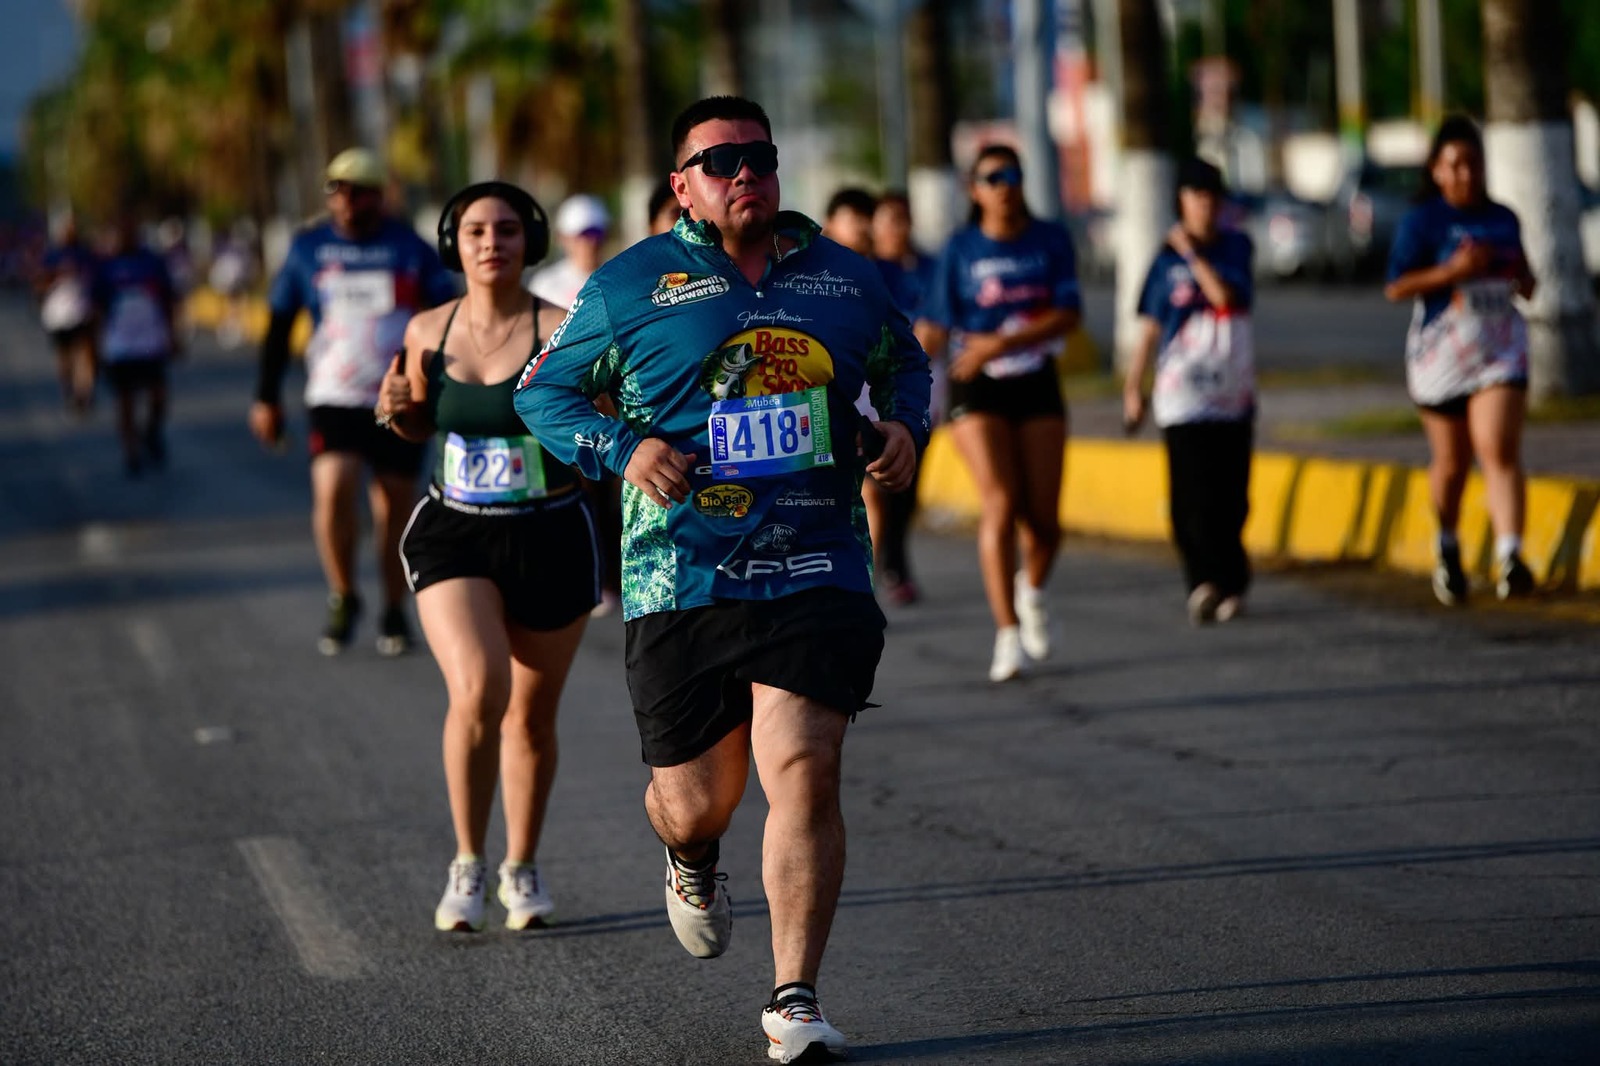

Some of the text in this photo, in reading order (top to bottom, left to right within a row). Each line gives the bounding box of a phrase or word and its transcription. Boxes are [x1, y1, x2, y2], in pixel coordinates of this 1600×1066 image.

[652, 275, 721, 304] Tournament
[669, 284, 725, 306] Rewards
[754, 330, 811, 357] Bass
[757, 351, 799, 376] Pro
[749, 398, 781, 409] Mubea
[732, 409, 799, 459] 418
[457, 453, 511, 488] 422
[817, 454, 829, 463] 418
[700, 496, 721, 507] Bio
